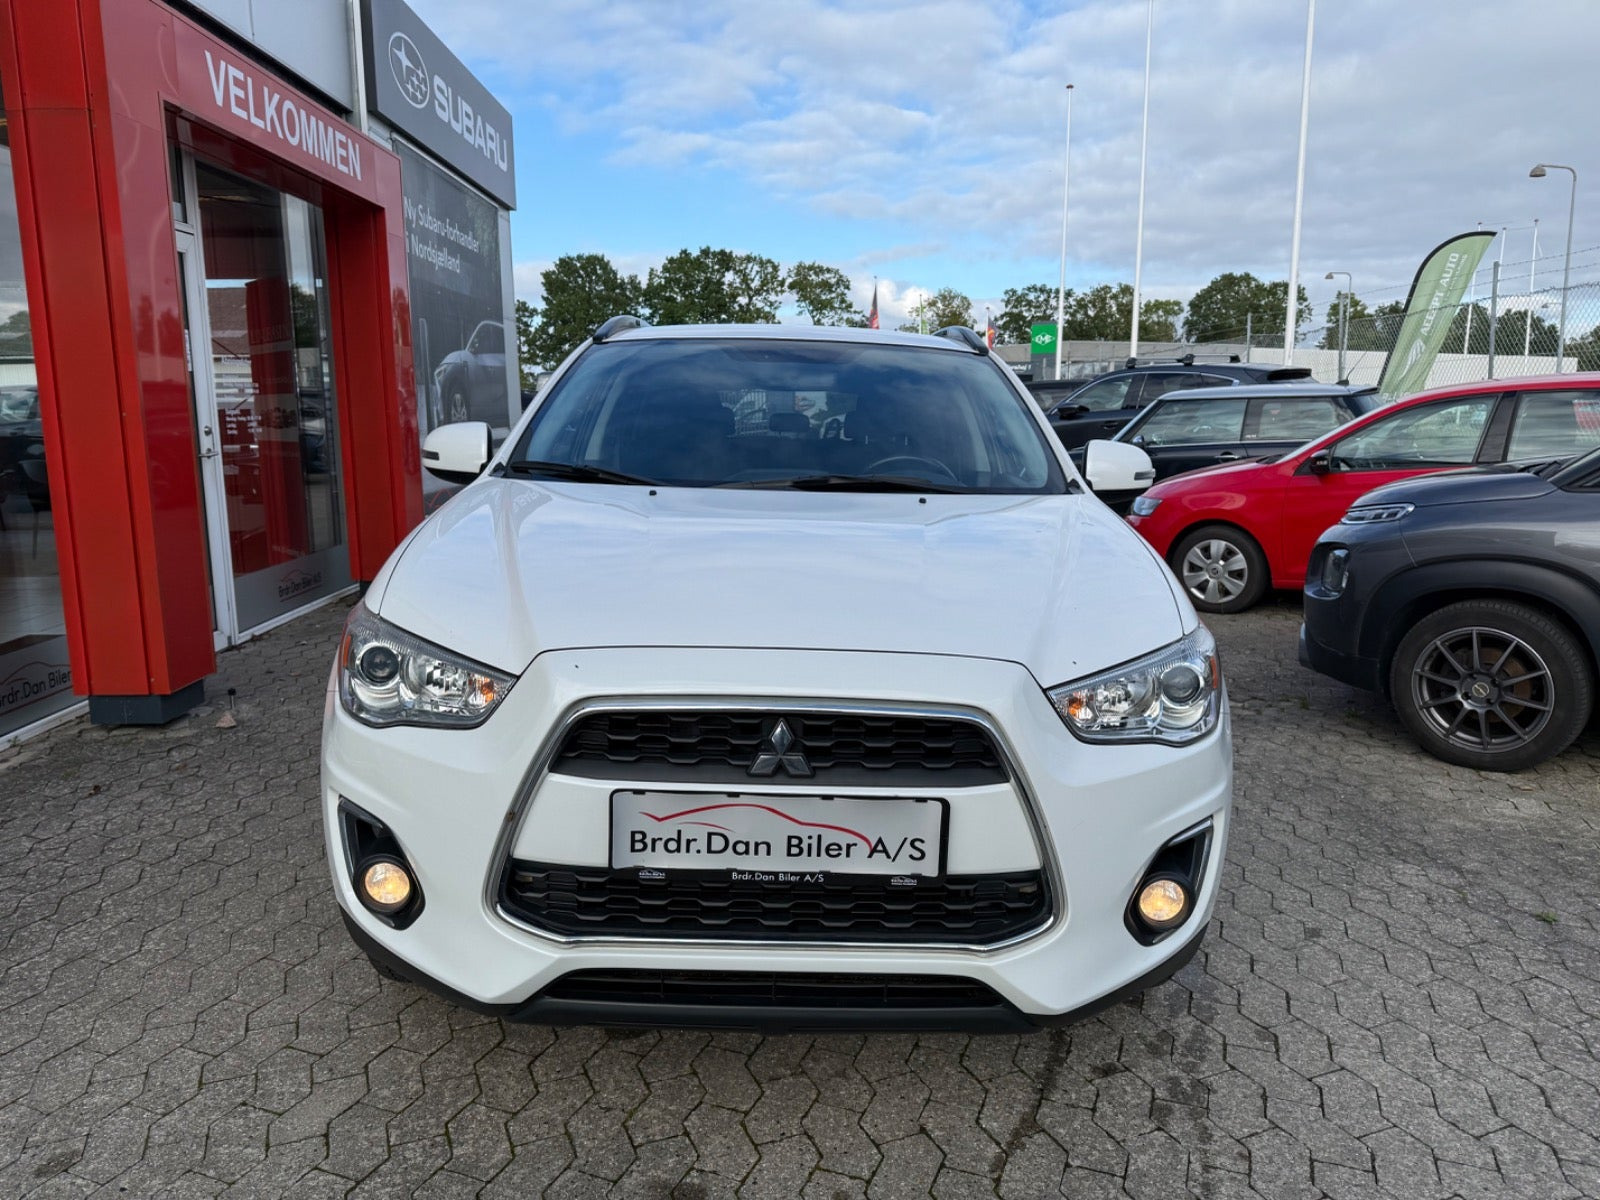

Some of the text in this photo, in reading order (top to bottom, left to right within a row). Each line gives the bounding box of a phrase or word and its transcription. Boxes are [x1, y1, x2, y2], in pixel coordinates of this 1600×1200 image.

[204, 49, 362, 182] VELKOMMEN
[433, 74, 508, 173] SUBARU
[403, 196, 480, 254] Ny Subaru-forhandler
[411, 232, 461, 274] Nordsjælland
[1439, 252, 1460, 288] AUTO
[48, 668, 72, 689] Biler
[785, 833, 858, 859] Biler
[867, 836, 927, 863] A/S
[778, 873, 800, 882] Biler
[803, 873, 825, 884] A/S
